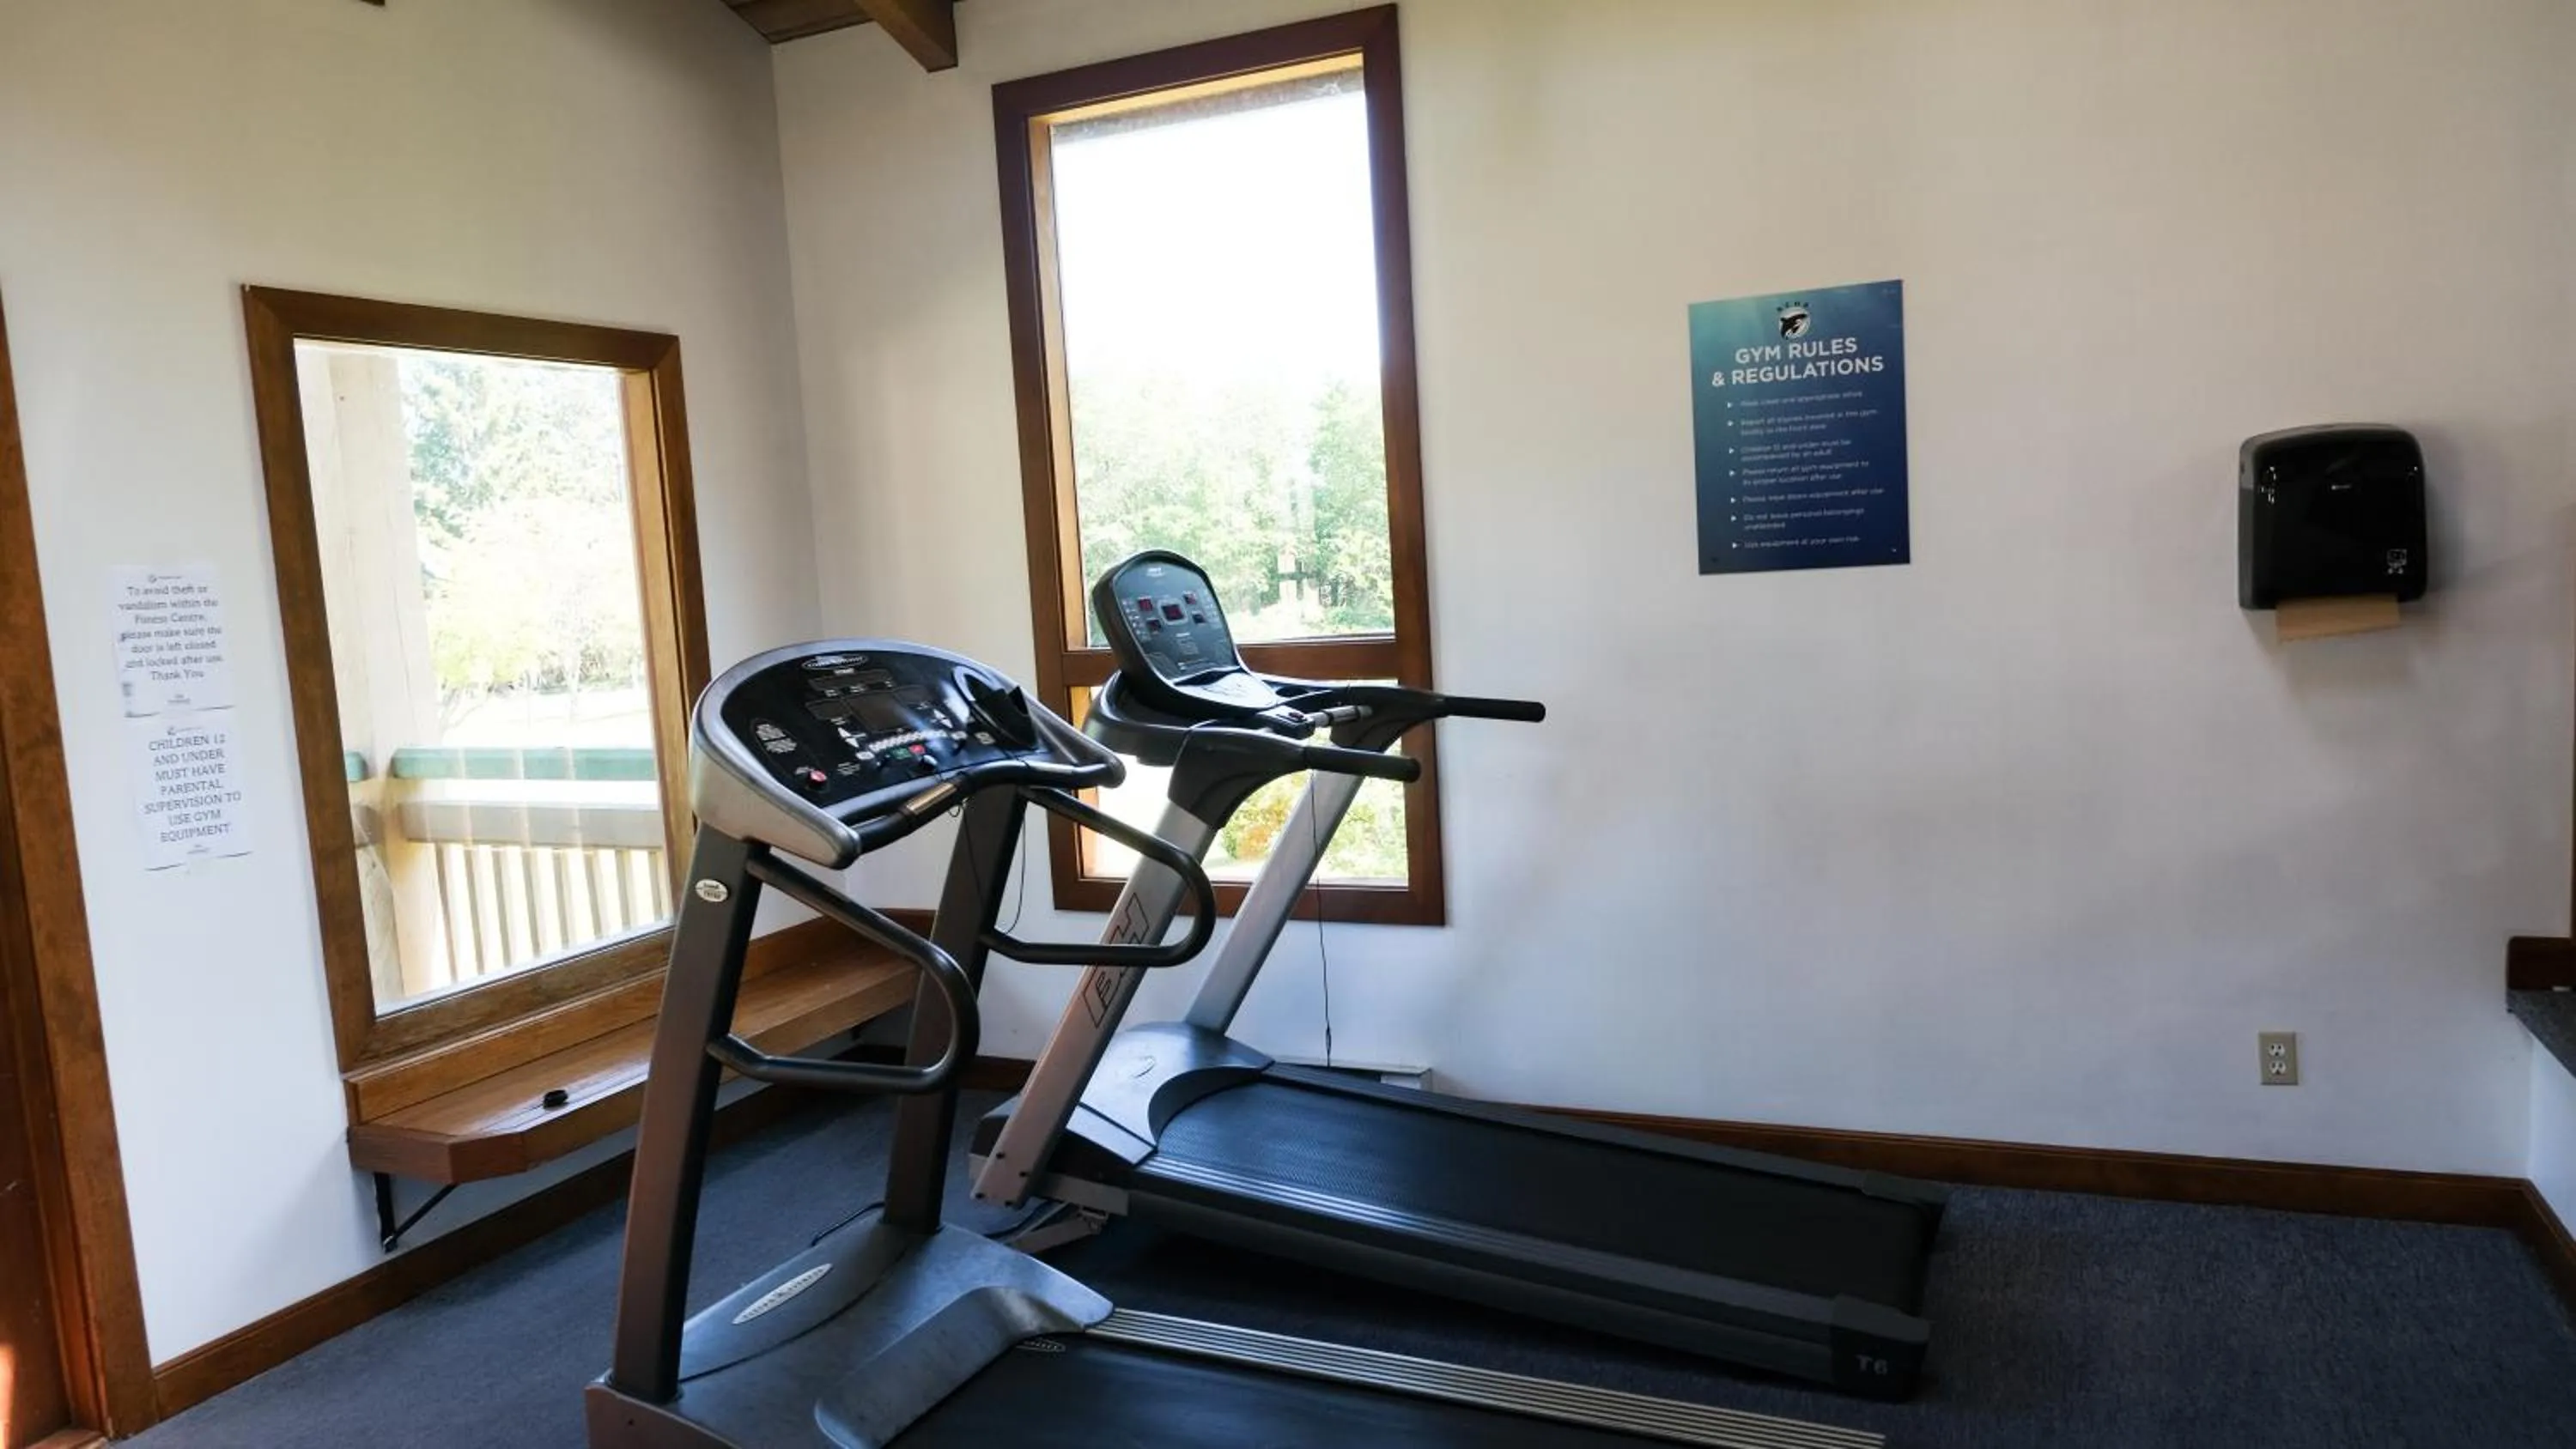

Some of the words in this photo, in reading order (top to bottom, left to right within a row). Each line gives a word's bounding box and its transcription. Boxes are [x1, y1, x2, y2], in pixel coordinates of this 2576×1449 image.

[1735, 345, 1781, 364] GYM
[1789, 337, 1857, 358] RULES
[1711, 372, 1725, 387] &
[1731, 356, 1885, 385] REGULATIONS
[127, 586, 140, 596] To
[143, 586, 169, 595] avoid
[172, 585, 195, 594] theft
[118, 601, 167, 610] vandalism
[170, 600, 201, 609] within
[120, 631, 152, 641] please
[154, 627, 180, 637] make
[184, 627, 205, 636] sure
[208, 627, 222, 635] the
[131, 645, 152, 653] door
[156, 643, 164, 652] is
[167, 641, 182, 652] left
[185, 640, 216, 650] closed
[125, 660, 143, 669] and
[146, 657, 178, 666] locked
[181, 655, 204, 664] after
[151, 670, 181, 681] Thank
[149, 735, 209, 751] CHILDREN
[153, 754, 179, 766] AND
[181, 749, 225, 762] UNDER
[155, 768, 188, 781] MUST
[191, 763, 226, 777] HAVE
[161, 779, 224, 795] PARENTAL
[144, 794, 222, 814] SUPERVISION
[225, 791, 242, 802] TO
[168, 814, 191, 826] USE
[194, 809, 222, 822] GYM
[161, 822, 231, 843] EQUIPMENT
[1856, 1355, 1888, 1375] T6
